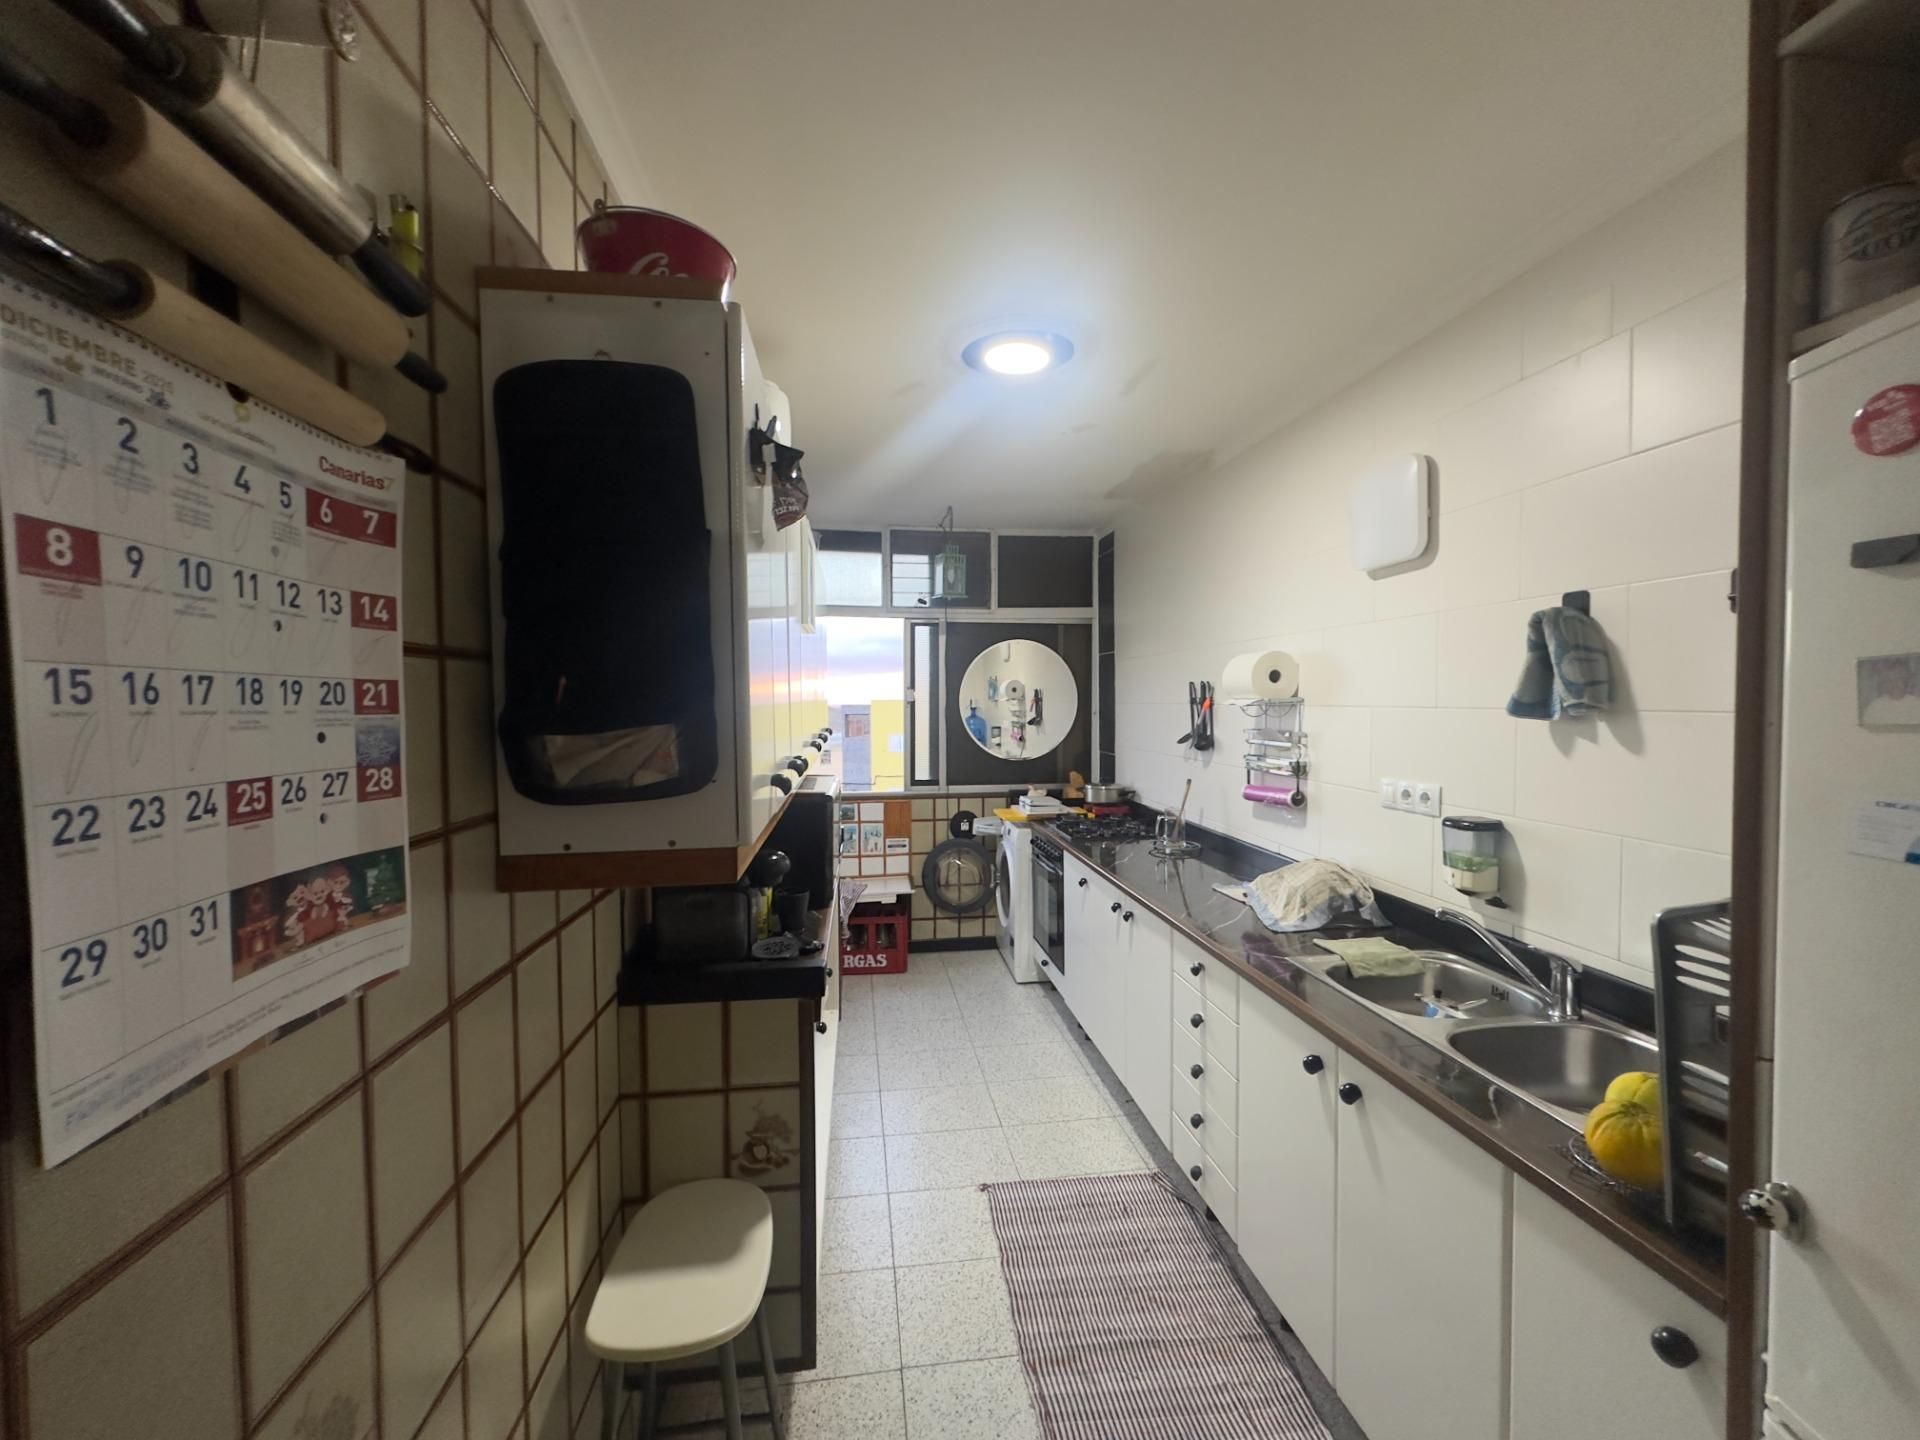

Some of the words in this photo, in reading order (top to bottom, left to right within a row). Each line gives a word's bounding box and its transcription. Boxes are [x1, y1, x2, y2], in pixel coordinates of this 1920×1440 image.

[1, 303, 137, 376] DICIEMBRE
[37, 388, 56, 425] 1
[118, 418, 138, 453] 2
[183, 443, 199, 474] 3
[235, 466, 250, 493] 4
[280, 482, 291, 508] 5
[320, 496, 334, 524] 6
[363, 510, 380, 534] 7
[47, 528, 72, 566] 8
[126, 546, 144, 578] 9
[179, 558, 211, 591] 10
[234, 570, 257, 600] 11
[277, 581, 300, 608] 12
[318, 589, 342, 615] 13
[360, 596, 390, 622] 14
[45, 668, 92, 705] 15
[123, 672, 159, 705] 16
[183, 675, 213, 705] 17
[237, 678, 263, 705] 18
[280, 680, 302, 705] 19
[320, 681, 345, 705] 20
[363, 683, 386, 705] 21
[52, 805, 100, 846] 22
[129, 796, 165, 832] 23
[187, 789, 217, 822] 24
[236, 781, 266, 813] 25
[281, 777, 306, 804] 26
[323, 772, 348, 798] 27
[366, 767, 393, 792] 28
[61, 940, 107, 987] 29
[134, 918, 167, 958] 30
[191, 901, 217, 936] 31
[844, 953, 887, 968] RGAS
